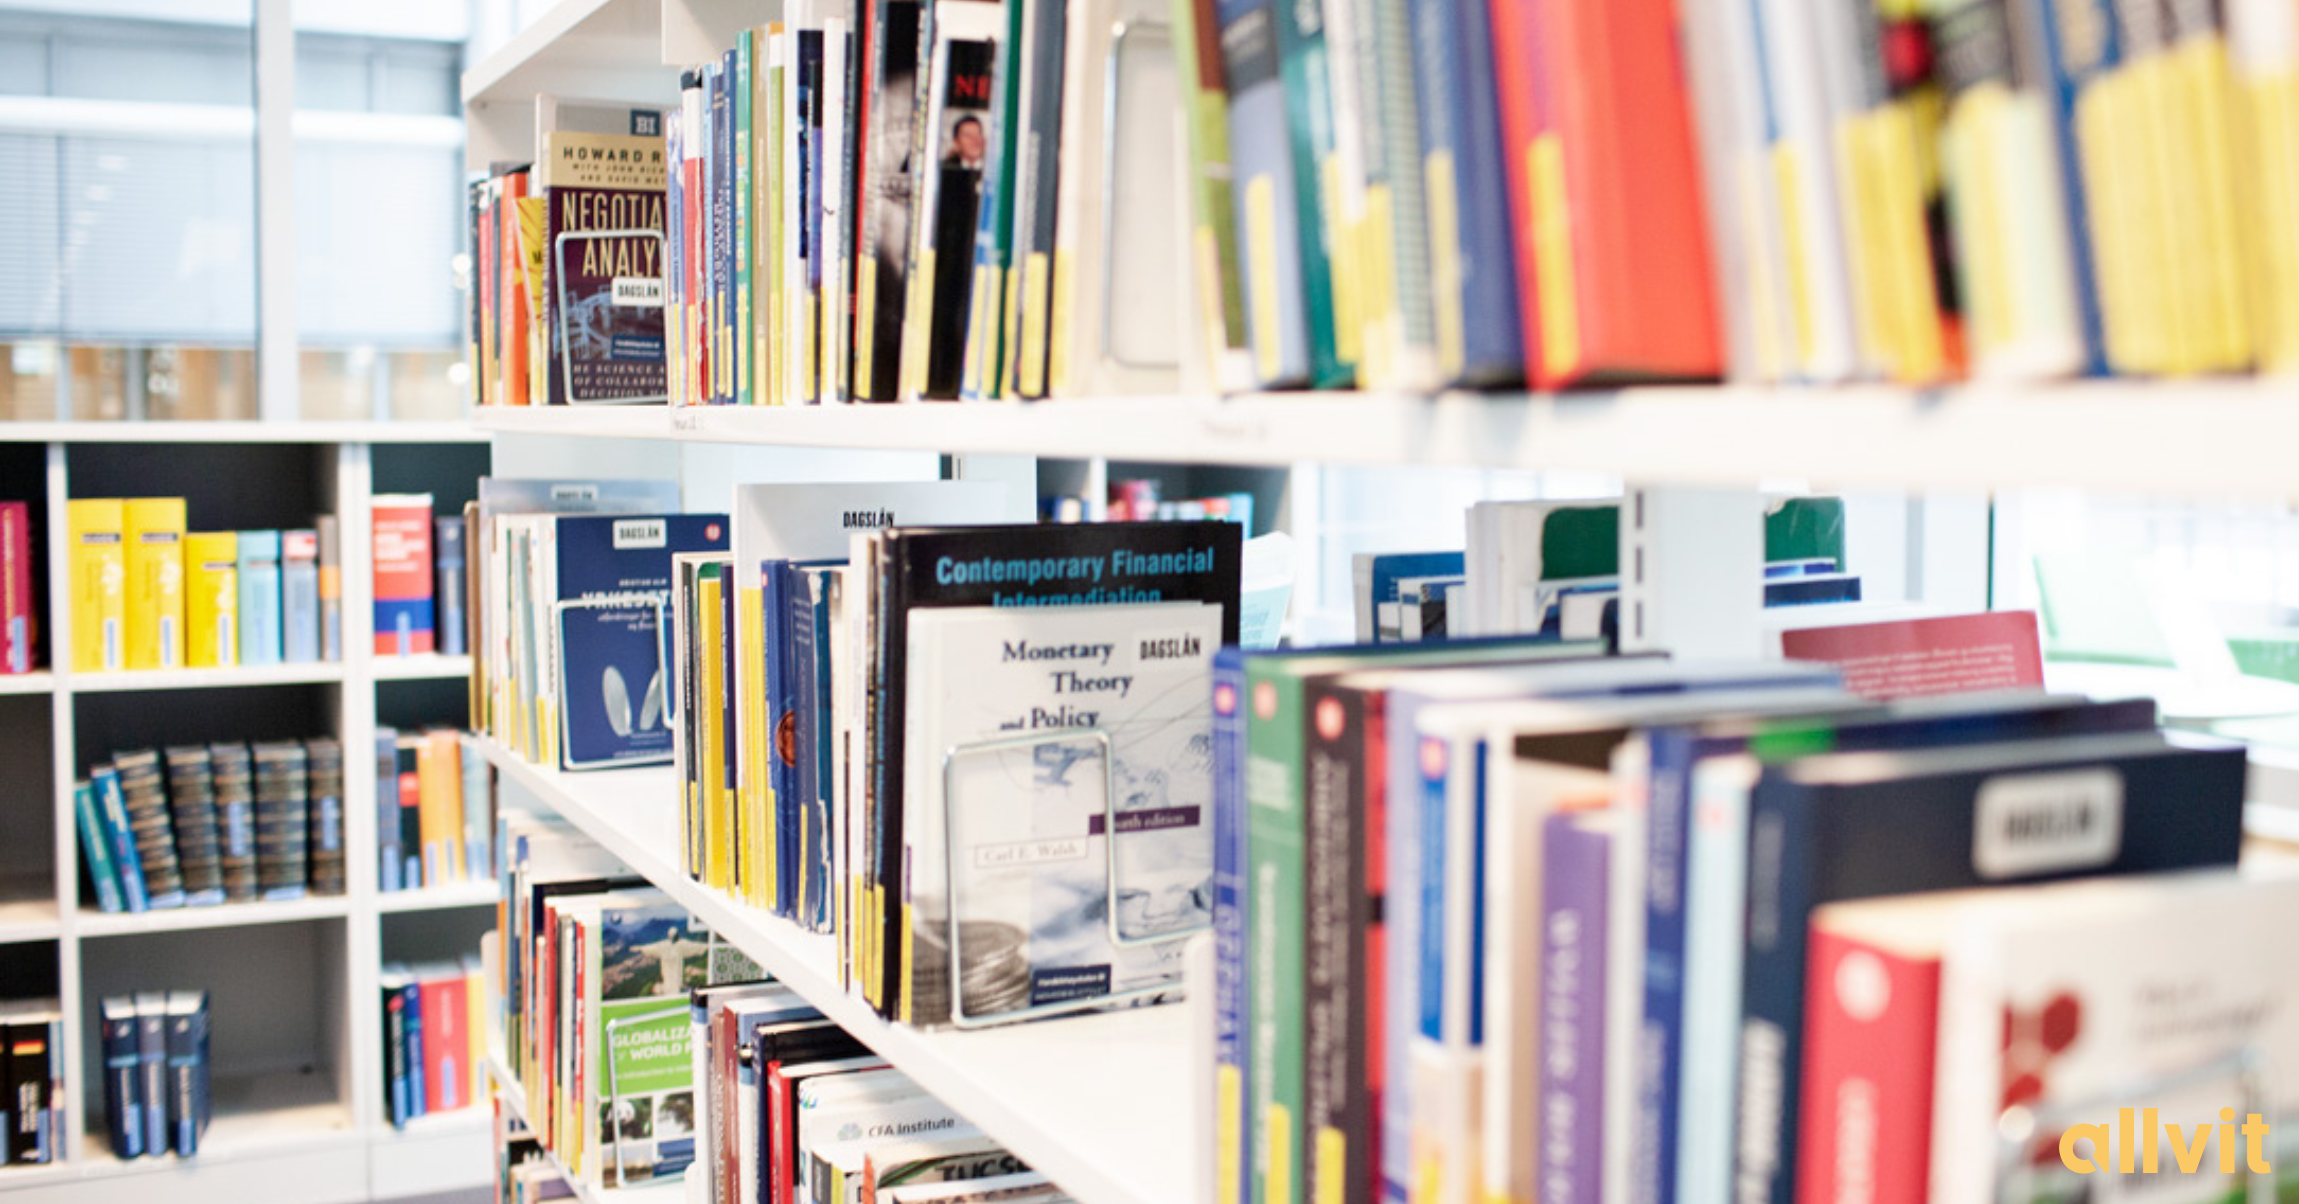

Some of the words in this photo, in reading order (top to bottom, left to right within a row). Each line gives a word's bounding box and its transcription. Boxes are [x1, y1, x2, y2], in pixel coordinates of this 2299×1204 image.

[636, 116, 656, 134] BI
[563, 146, 643, 163] HOWARD
[562, 191, 665, 232] NEGOTIA
[581, 237, 661, 279] ANALY
[843, 507, 895, 528] DAGSLÅN
[935, 555, 1105, 587] Contemporary
[1111, 546, 1214, 577] Financial
[1002, 638, 1114, 665] Monetary
[1140, 631, 1201, 660] DAGSLÅN
[1050, 671, 1133, 696] Theory
[1000, 718, 1024, 730] and
[1030, 706, 1099, 730] Policy
[1144, 812, 1185, 828] edition
[629, 1042, 682, 1061] WORLD
[868, 1125, 894, 1137] CFA
[897, 1117, 955, 1135] Institute
